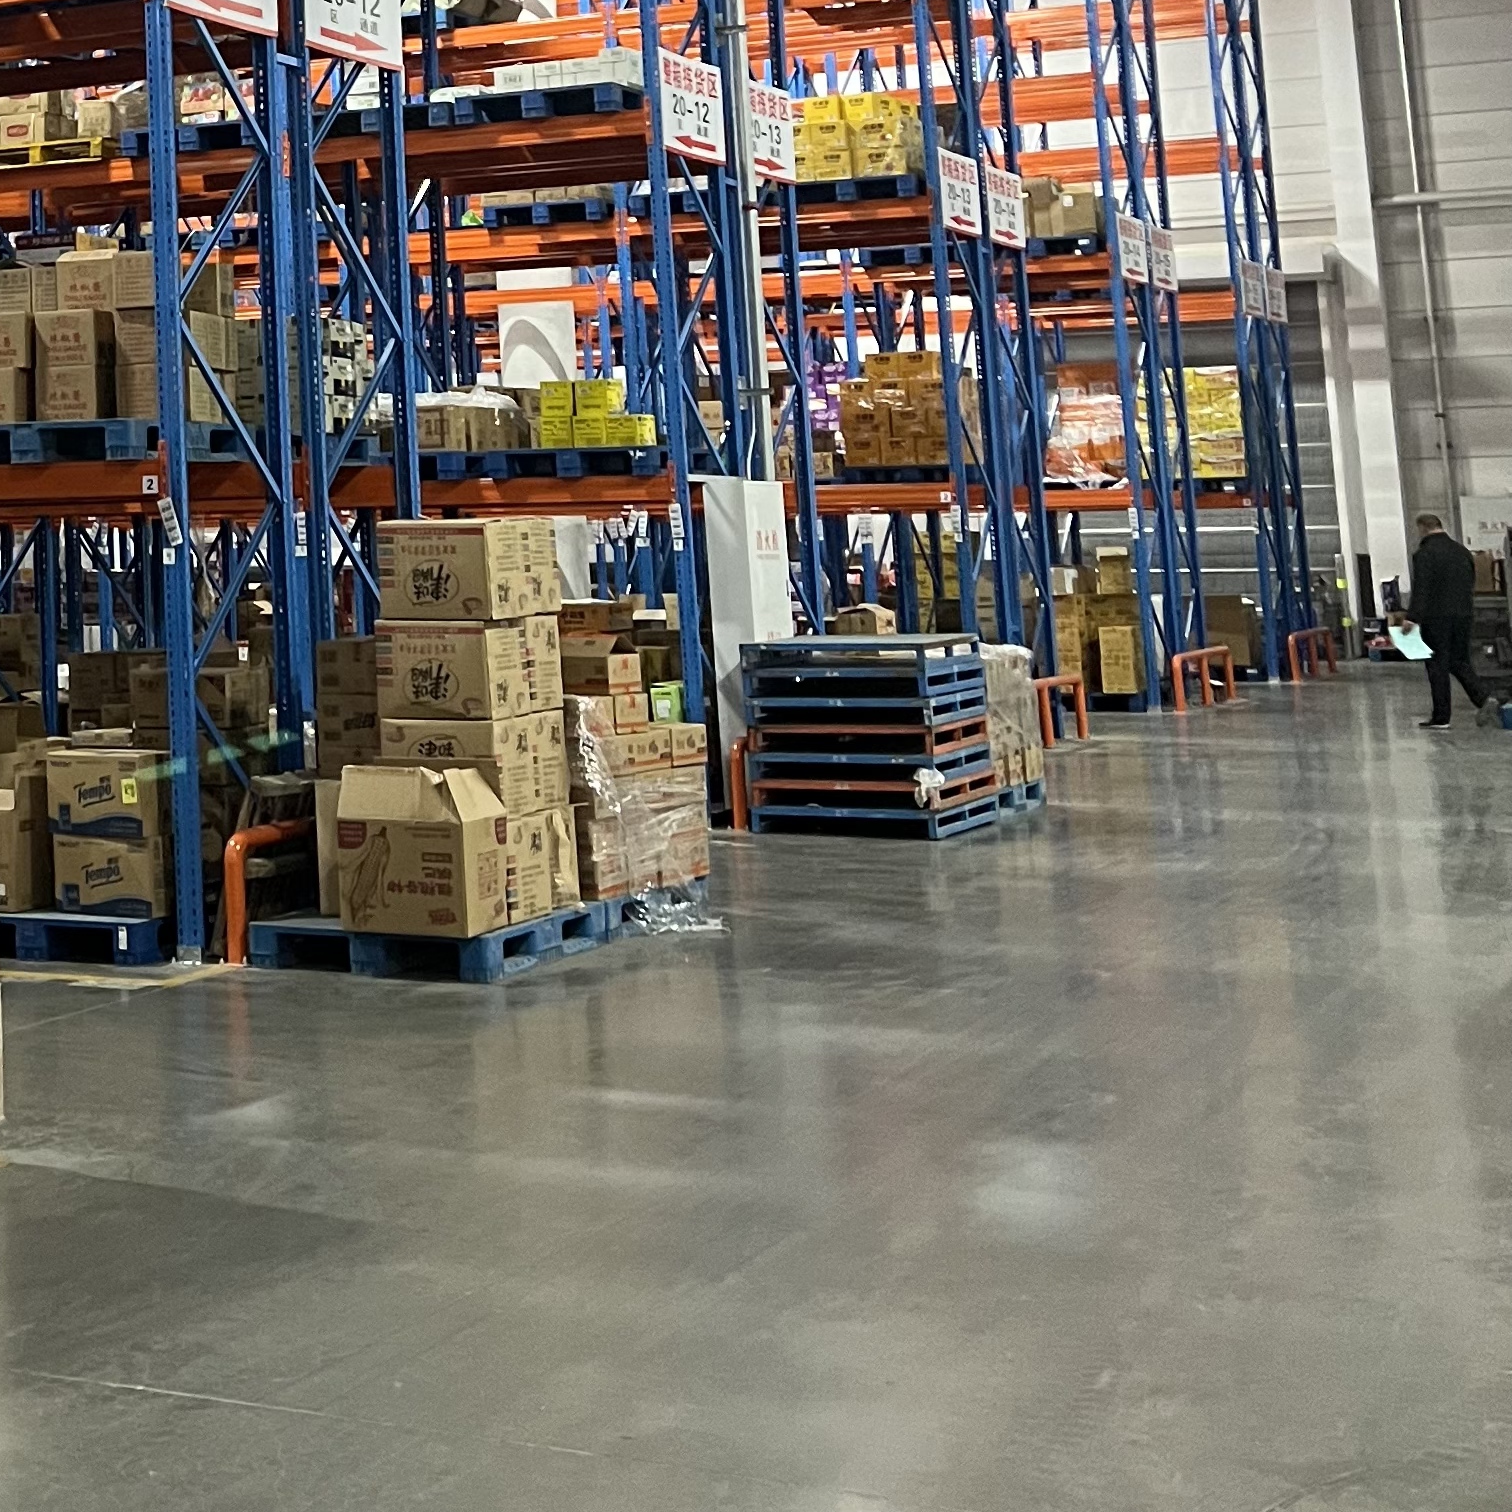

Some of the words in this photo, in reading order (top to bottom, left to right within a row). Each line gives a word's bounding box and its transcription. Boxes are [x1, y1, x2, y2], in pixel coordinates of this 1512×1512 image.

[672, 93, 710, 124] 20-12
[752, 119, 781, 145] 0-13
[146, 479, 154, 490] 2
[73, 781, 112, 803] Tempo
[80, 862, 120, 885] Tempo
